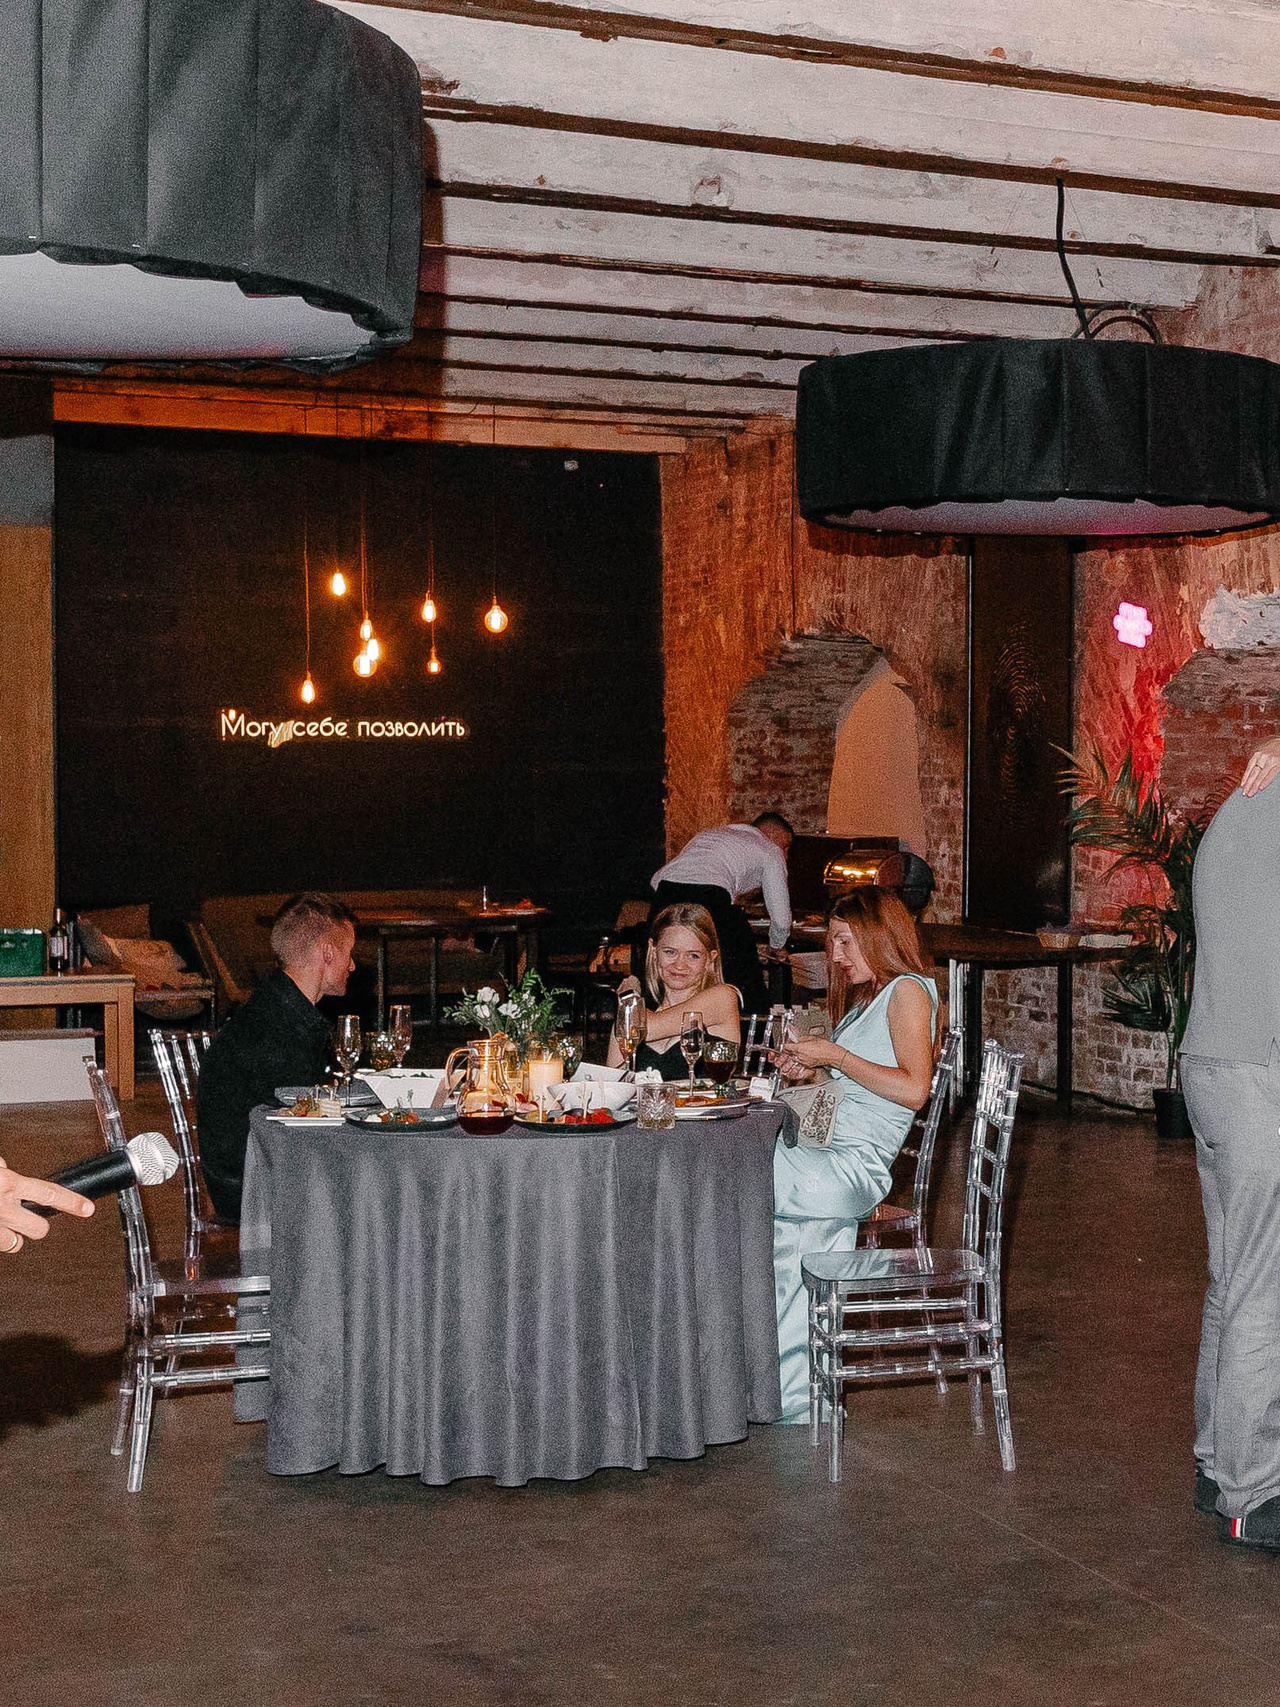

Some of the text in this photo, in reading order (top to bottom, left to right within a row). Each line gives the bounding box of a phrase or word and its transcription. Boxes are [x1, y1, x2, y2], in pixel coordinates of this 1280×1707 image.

[221, 712, 466, 743] Могу себе позволить
